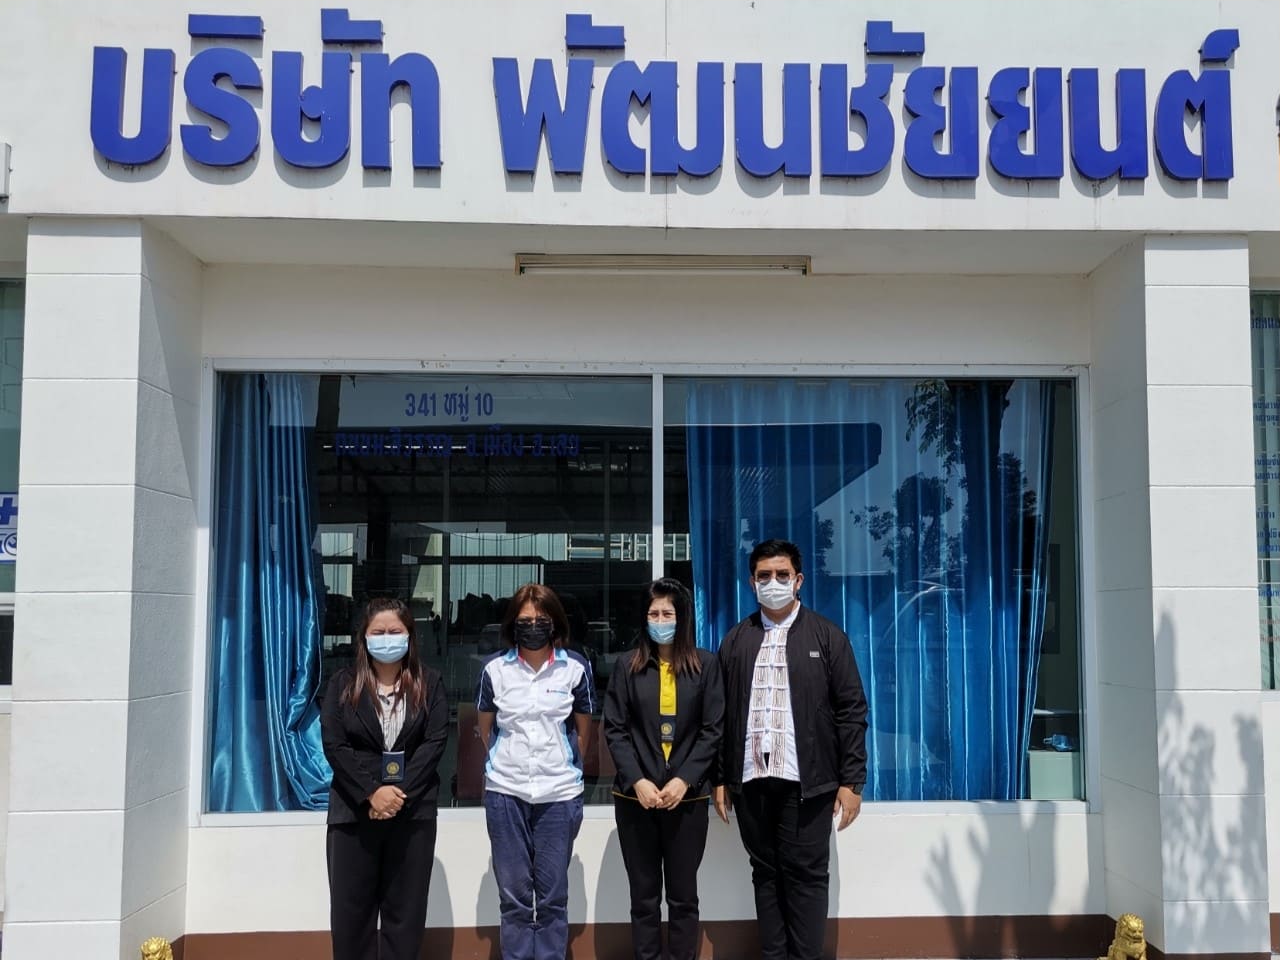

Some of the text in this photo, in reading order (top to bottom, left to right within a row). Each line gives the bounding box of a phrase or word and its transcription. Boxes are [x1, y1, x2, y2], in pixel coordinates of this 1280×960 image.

[90, 8, 1241, 182] บริษัท พัฒนชัยยนต์
[404, 384, 494, 423] 341 หมู่ 10
